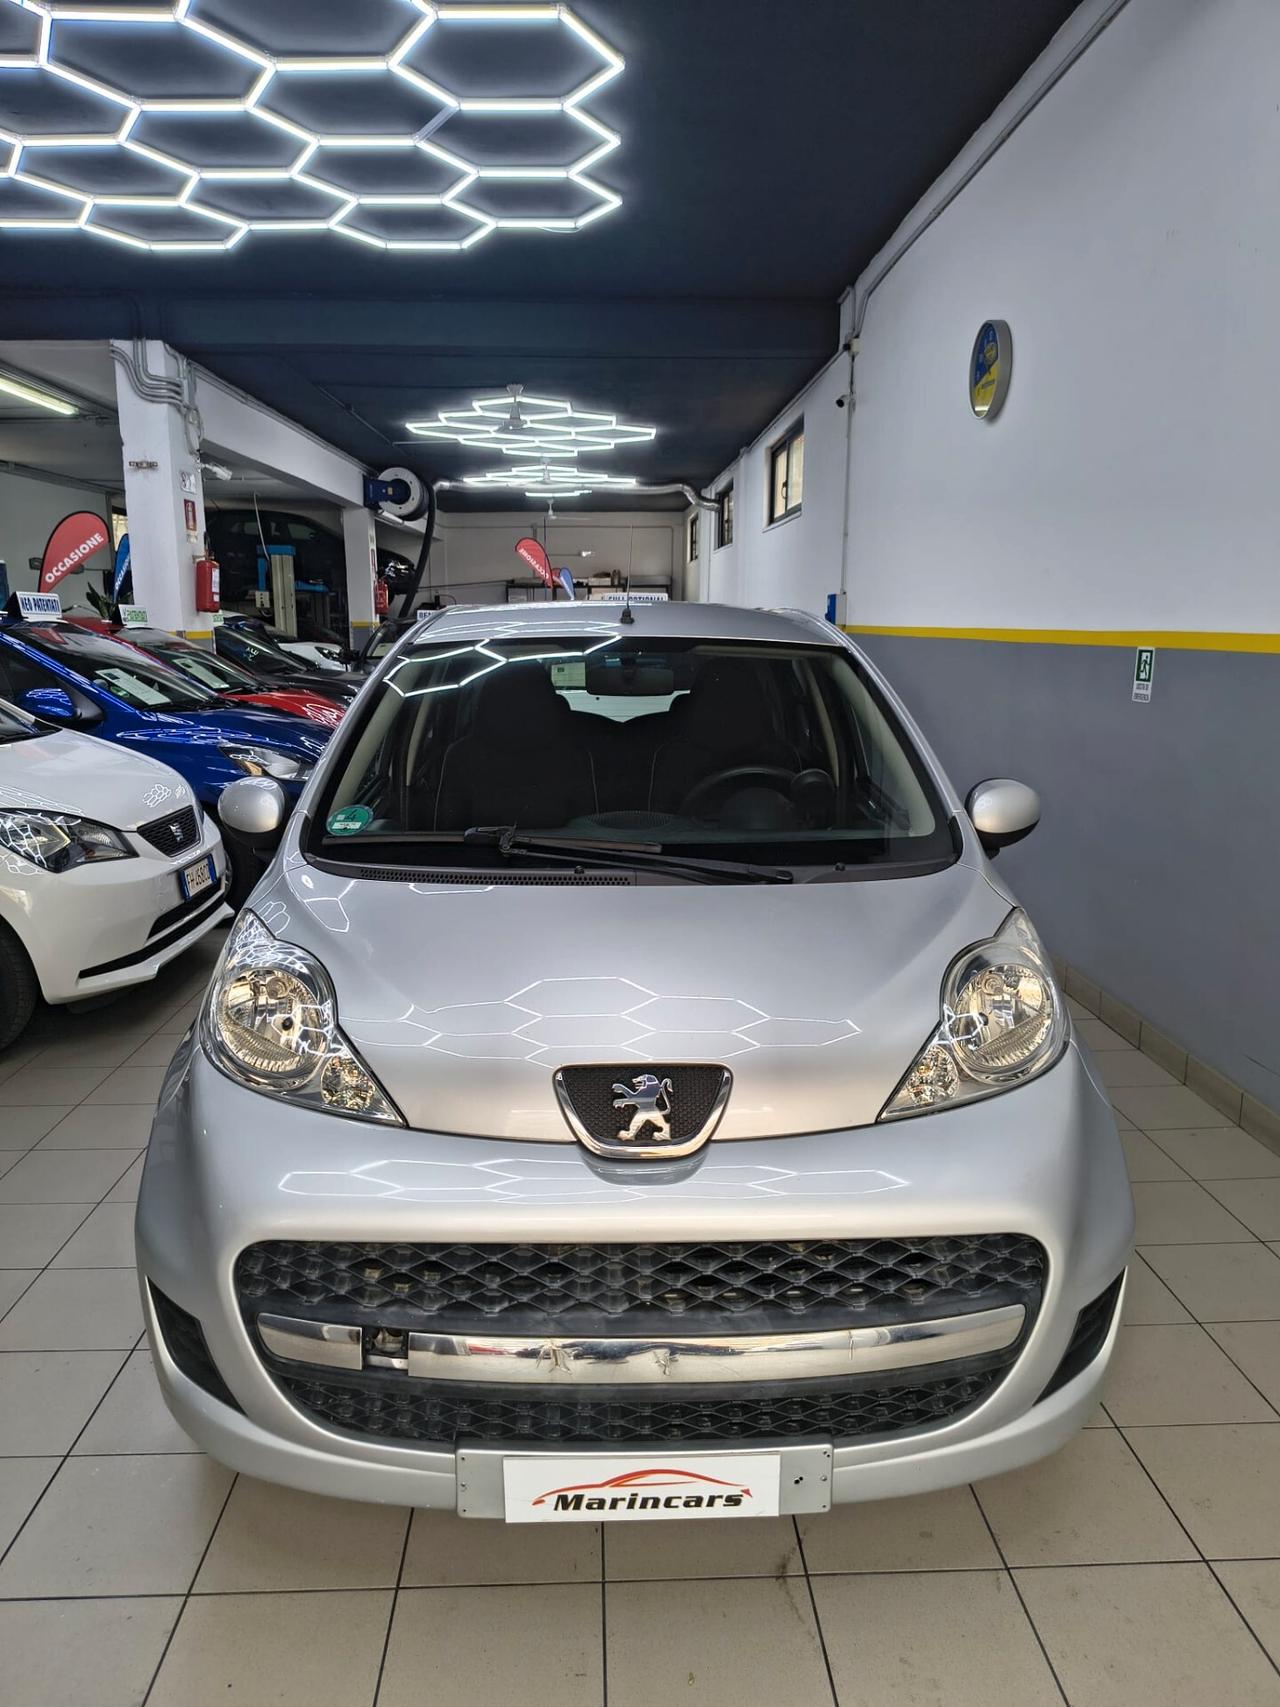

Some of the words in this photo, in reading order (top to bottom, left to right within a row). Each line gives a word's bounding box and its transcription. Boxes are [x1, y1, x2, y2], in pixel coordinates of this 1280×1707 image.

[45, 532, 104, 583] OCCASIONE
[20, 597, 33, 611] NEO
[553, 1492, 743, 1512] Marincars
